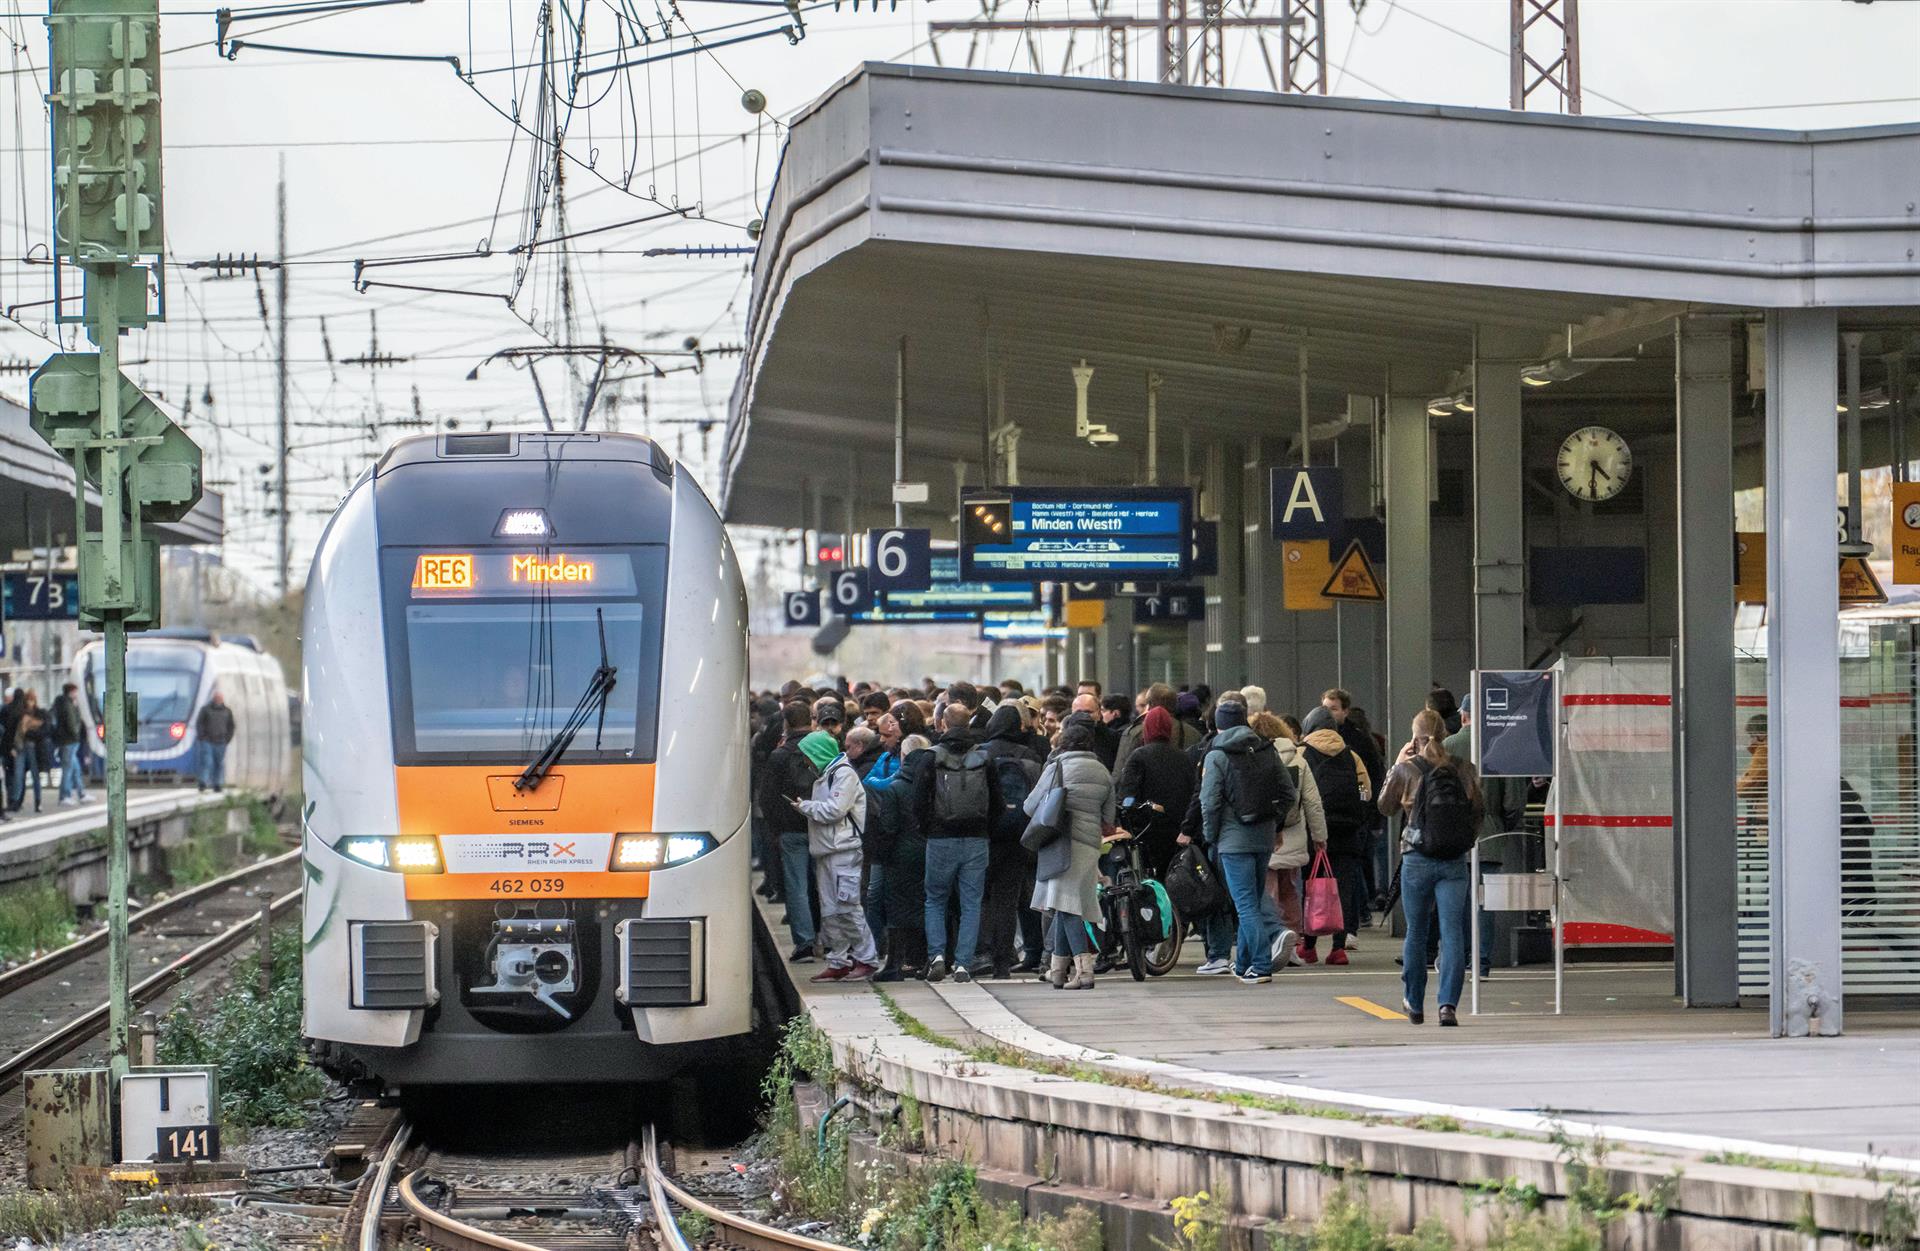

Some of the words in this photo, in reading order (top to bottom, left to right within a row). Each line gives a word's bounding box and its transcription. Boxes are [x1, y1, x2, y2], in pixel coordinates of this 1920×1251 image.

[1282, 471, 1325, 523] A
[1032, 518, 1073, 530] Minden
[1077, 518, 1122, 531] (Westf)
[877, 530, 908, 577] 6
[424, 559, 466, 585] RE6
[512, 554, 594, 582] Minden
[26, 577, 45, 605] 7
[836, 572, 859, 605] 6
[788, 591, 809, 621] 6
[502, 841, 577, 859] RRX
[489, 878, 524, 893] 462
[529, 878, 565, 893] 039
[168, 1130, 208, 1157] 141
